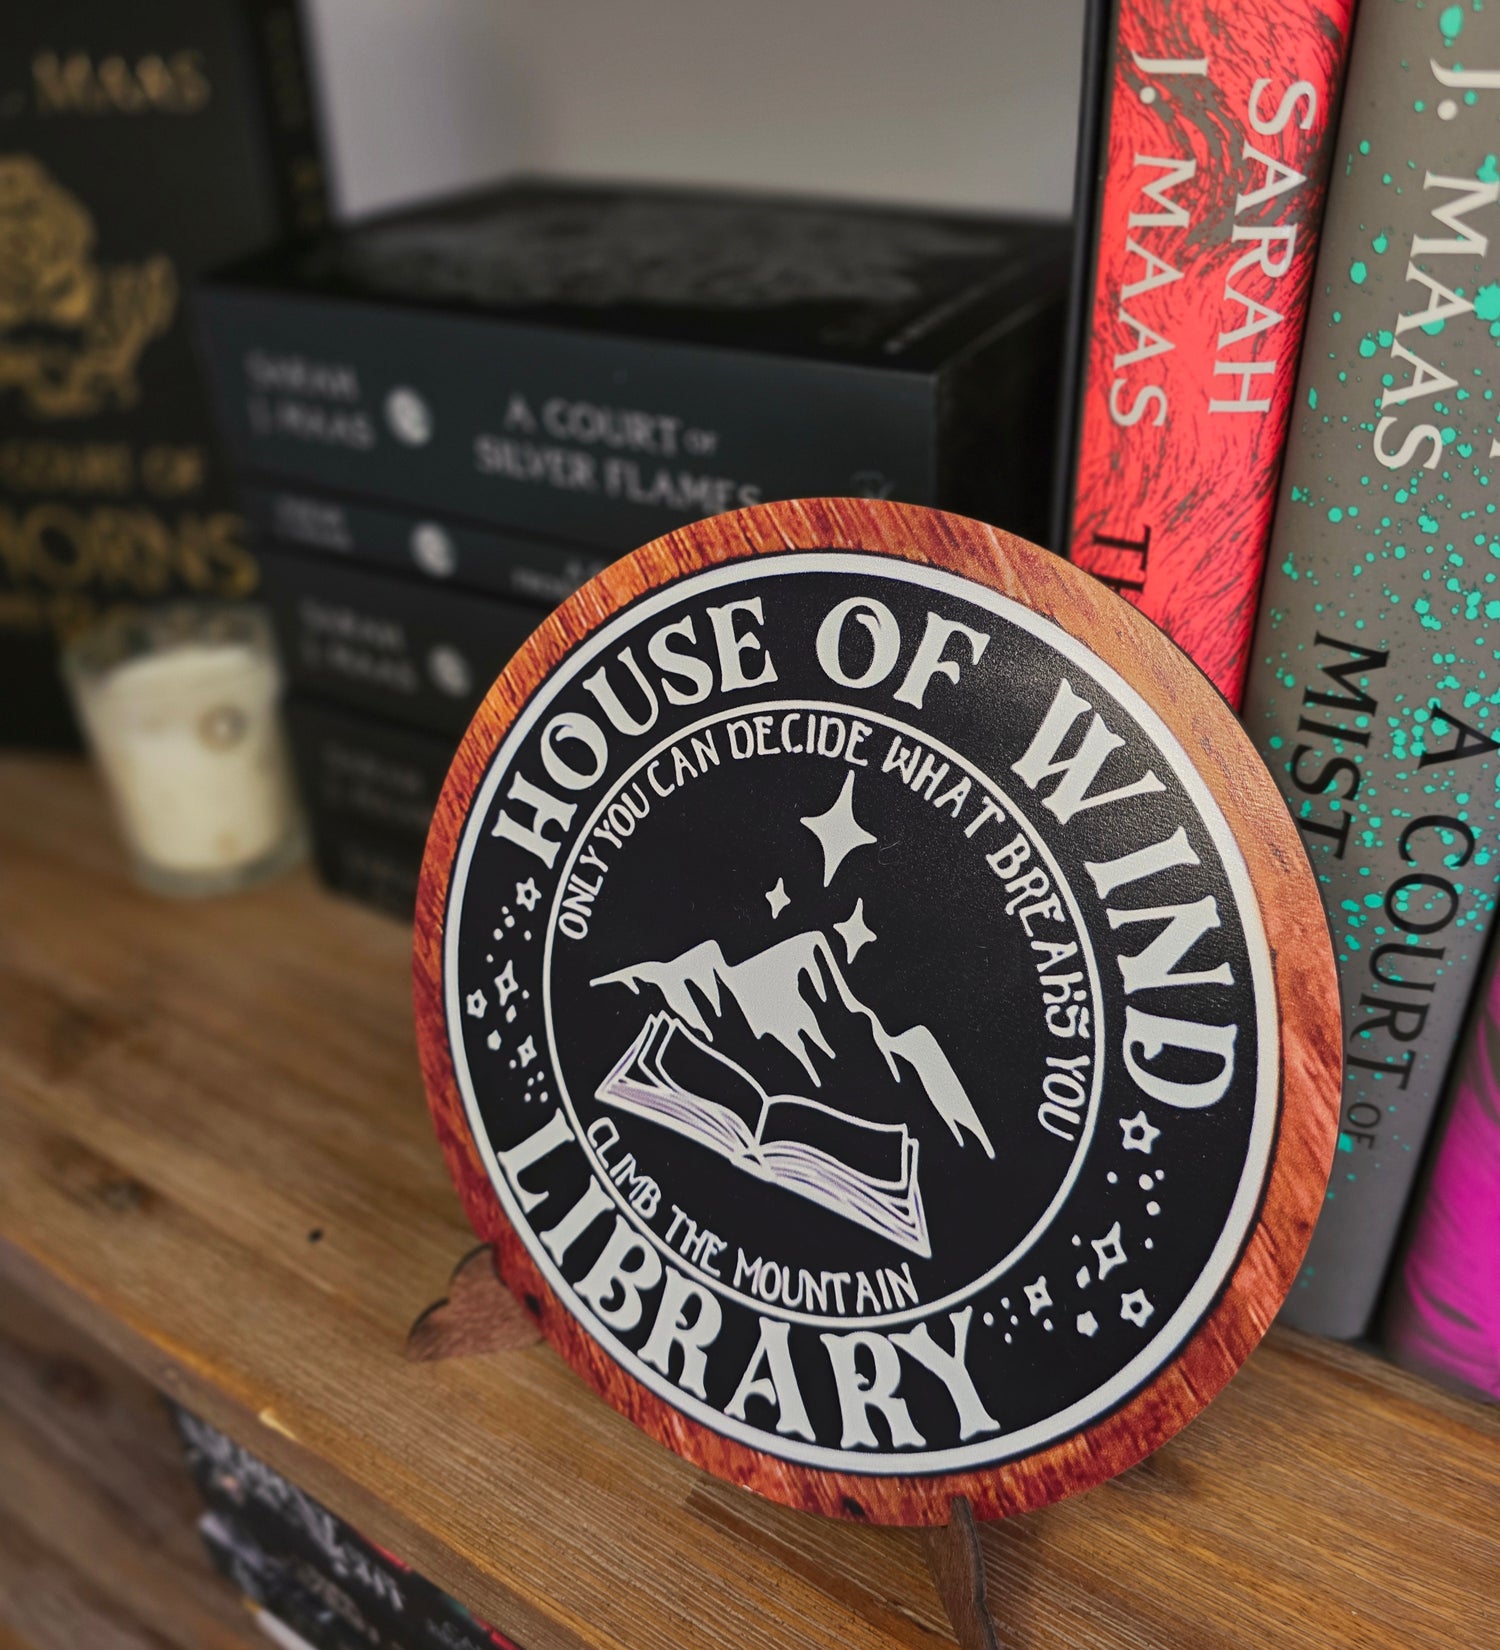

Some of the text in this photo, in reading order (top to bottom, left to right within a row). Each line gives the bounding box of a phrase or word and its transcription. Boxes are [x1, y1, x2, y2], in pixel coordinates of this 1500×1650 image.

[1109, 50, 1208, 427] J. MAAS
[1208, 77, 1317, 415] SARAH
[1373, 170, 1500, 470] MAAS
[472, 434, 762, 515] SILVER FLAMES
[503, 394, 537, 432] A
[541, 397, 683, 457] COURT
[491, 596, 1238, 1109] HOUSE OF WIND
[1289, 631, 1389, 861] MIST
[559, 713, 1091, 1141] ONLY YOU CAN DECIDE WHAT BREAKS YOU
[1345, 702, 1500, 1151] A COURT OF
[497, 1107, 1001, 1449] LIBRARY
[586, 1116, 919, 1314] CLIMB THE MOUNTAIN
